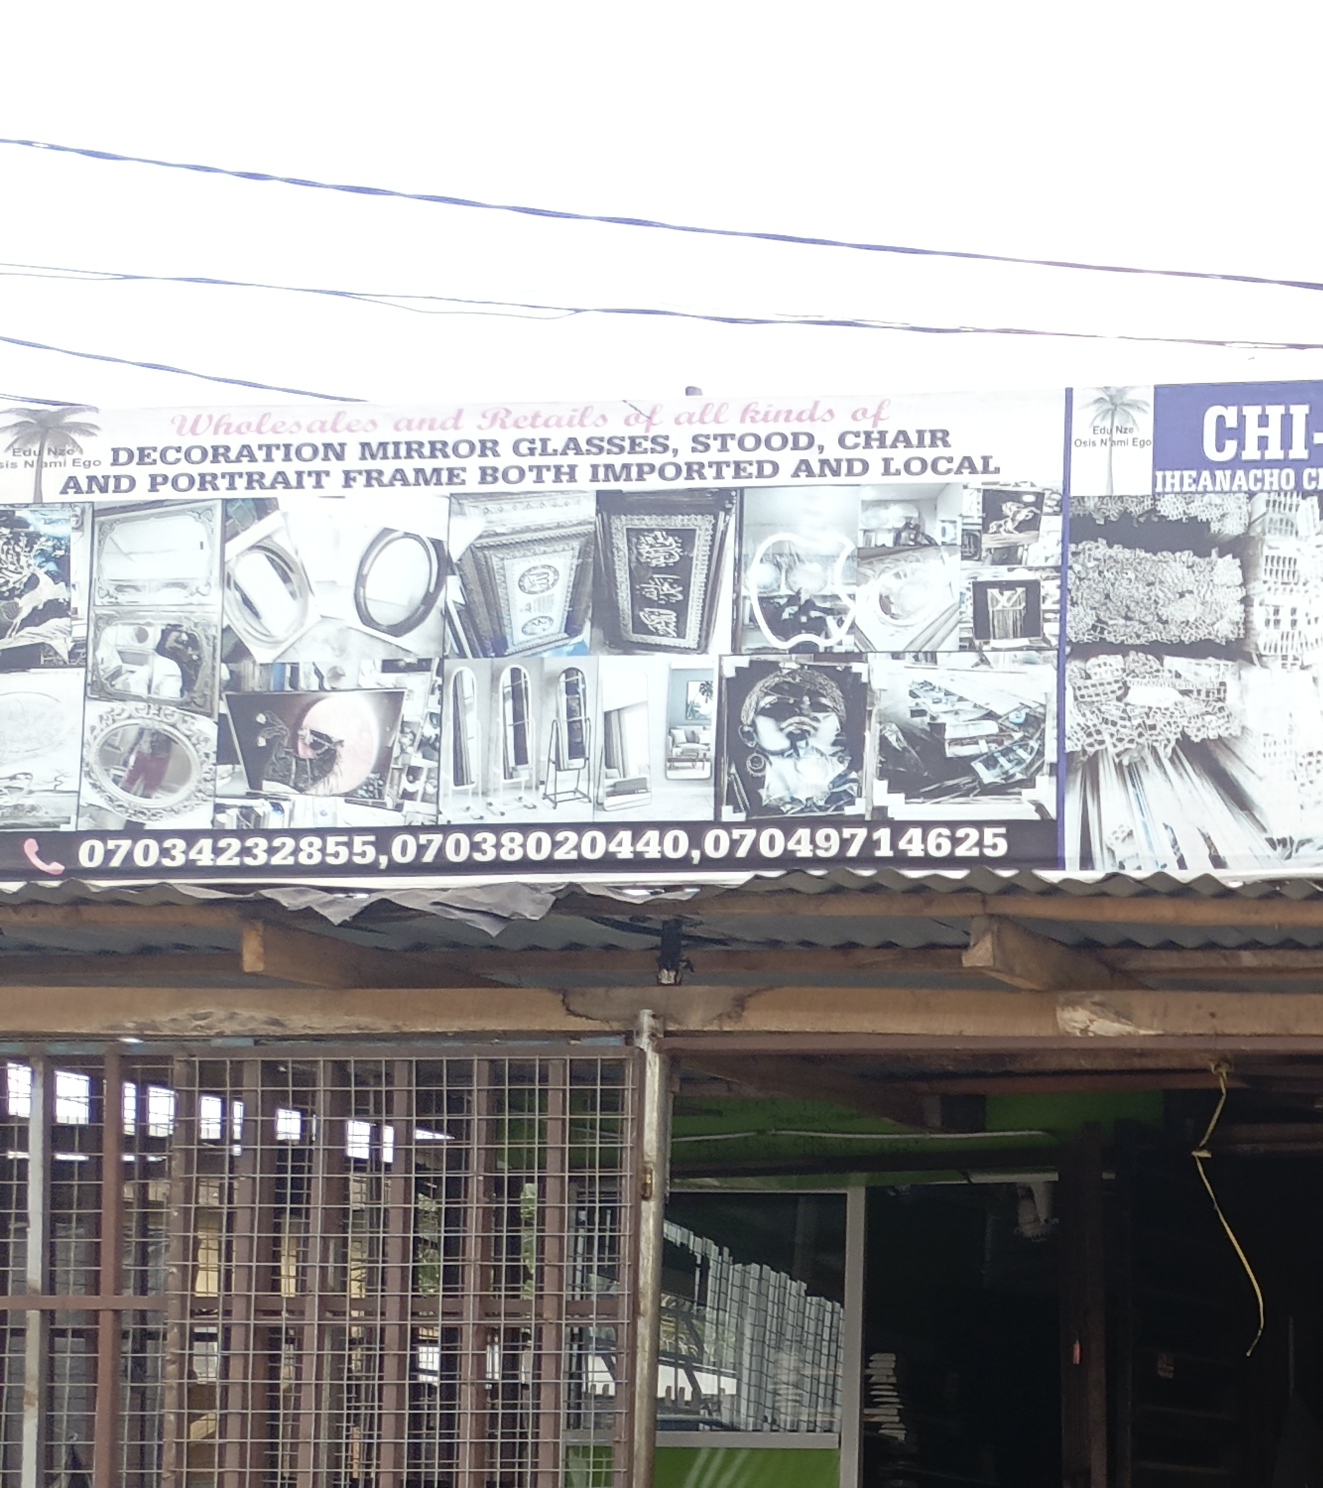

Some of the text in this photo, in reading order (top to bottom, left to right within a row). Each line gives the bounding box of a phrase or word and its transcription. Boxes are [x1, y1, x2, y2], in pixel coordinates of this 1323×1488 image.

[172, 393, 890, 437] Wholesales and Retails of all kinds of
[110, 427, 952, 467] DECORATION MIRROR GLASSES, STOOD, CHAIR
[1074, 438, 1097, 448] Osis
[1132, 438, 1152, 449] Ego
[60, 453, 1002, 495] AND PORTRAIT FRAME BOTH IMPORTED AND LOCAL
[72, 457, 102, 468] Ego
[1155, 467, 1296, 494] IHEANACHO
